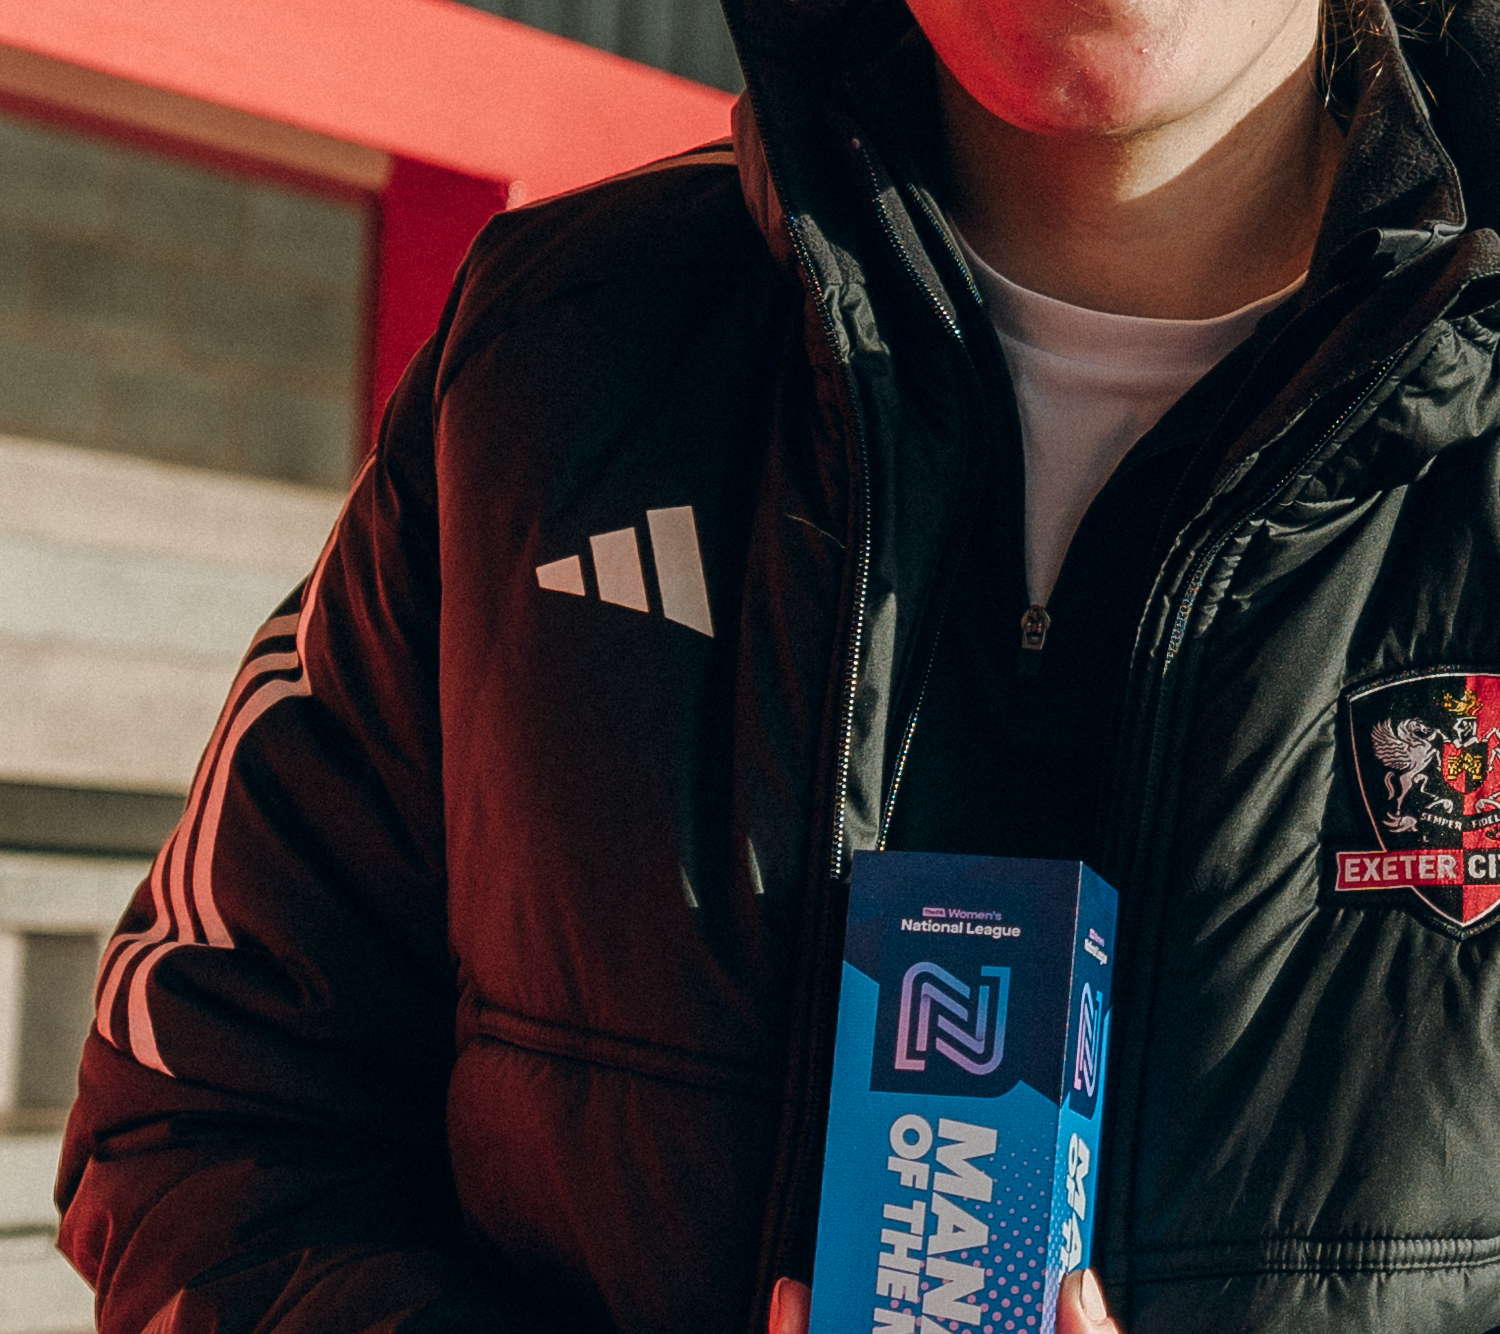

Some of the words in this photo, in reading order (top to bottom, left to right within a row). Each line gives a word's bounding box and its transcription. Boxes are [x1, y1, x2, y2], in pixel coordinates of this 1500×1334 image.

[1420, 811, 1463, 830] SEMPER
[1344, 853, 1457, 882] EXETER
[948, 908, 1002, 921] Women's
[900, 918, 964, 934] National
[966, 922, 1021, 939] League
[887, 1113, 934, 1191] OF
[876, 1200, 927, 1303] THE
